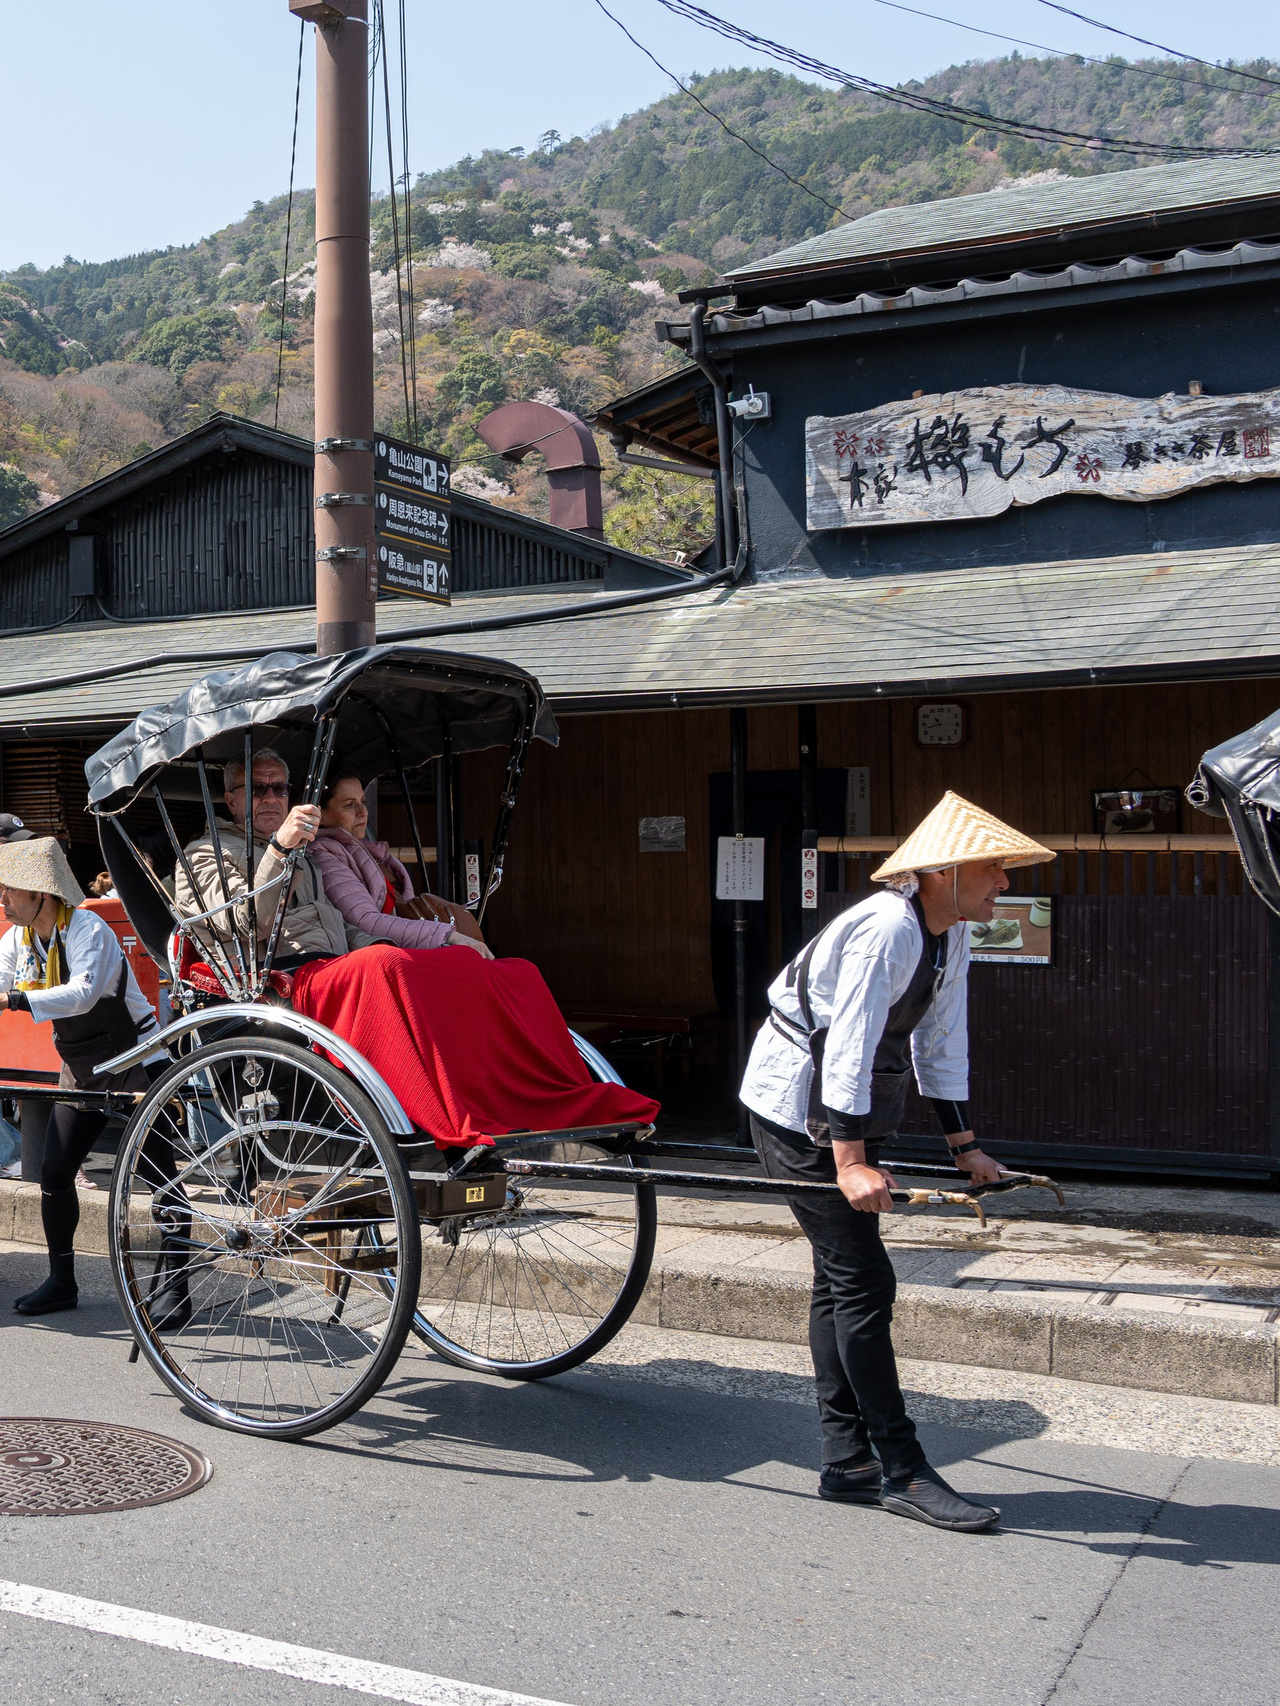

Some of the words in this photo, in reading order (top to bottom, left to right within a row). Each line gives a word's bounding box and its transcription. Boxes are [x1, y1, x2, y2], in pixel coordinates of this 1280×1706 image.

[389, 447, 423, 475] 亀山公園
[1121, 429, 1240, 471] 琴きき茶屋
[388, 468, 412, 483] Kameyama
[412, 476, 423, 487] Park
[388, 498, 437, 529] 周恩来記念碑
[385, 519, 409, 533] Monument
[408, 526, 414, 534] of
[414, 527, 425, 538] Chou
[425, 530, 437, 541] En-lai
